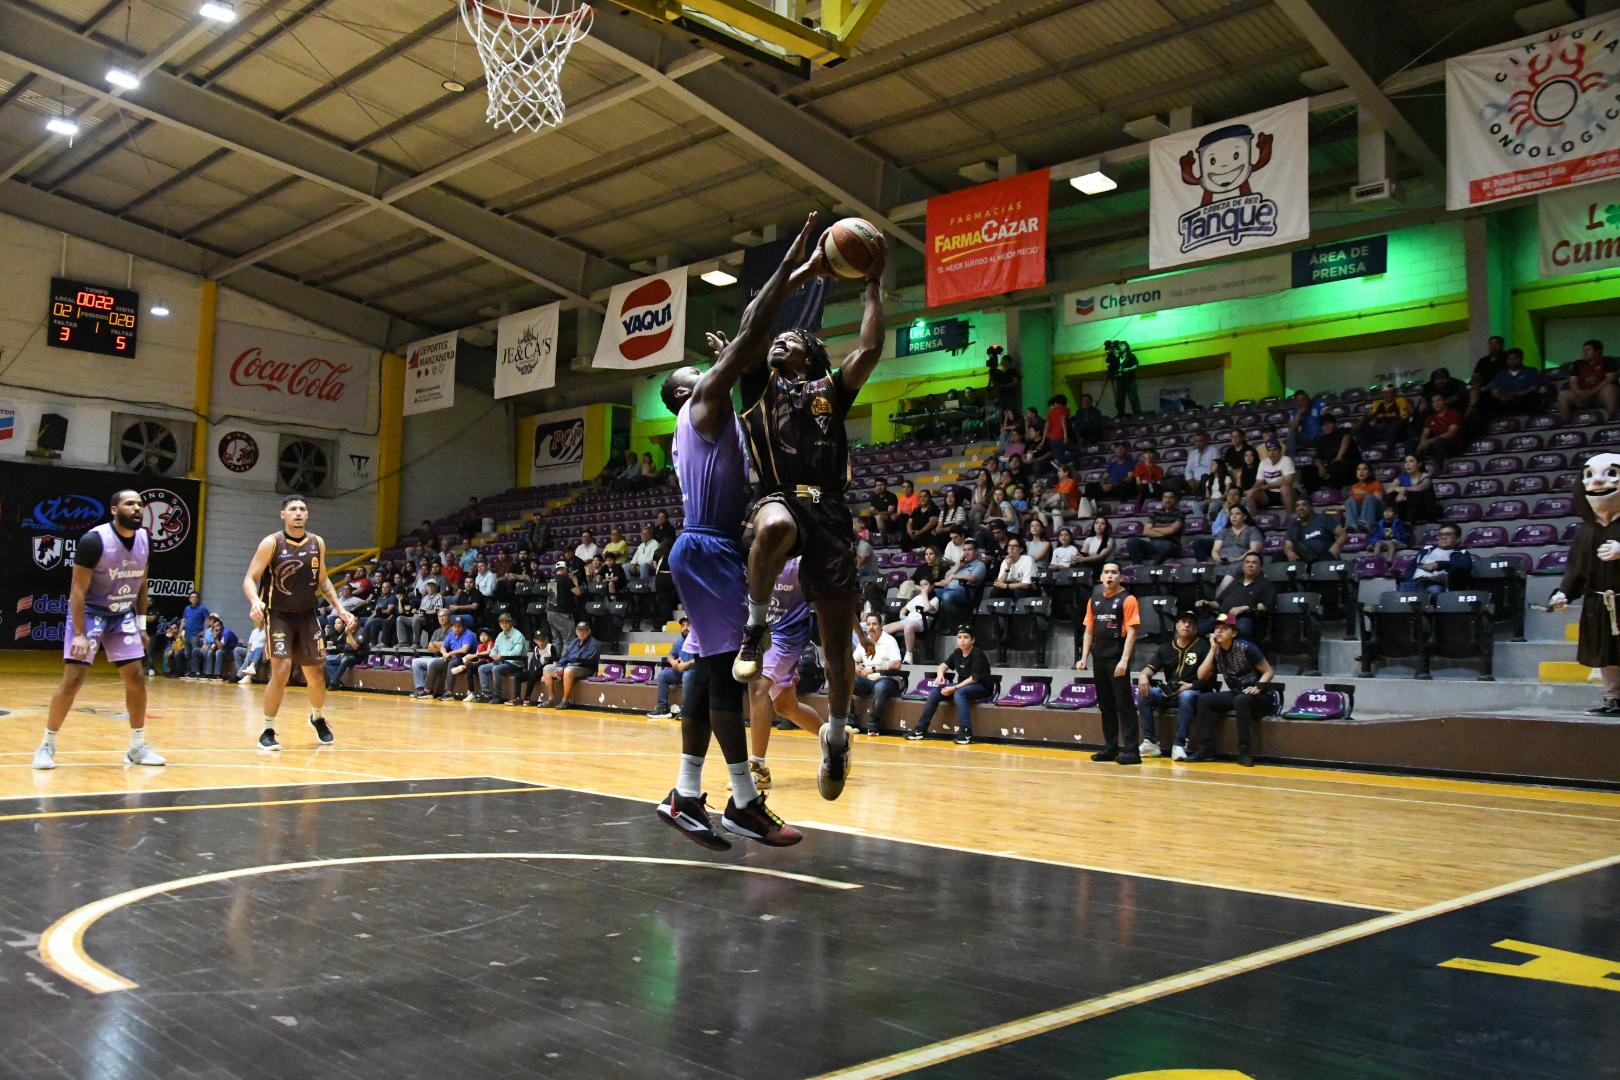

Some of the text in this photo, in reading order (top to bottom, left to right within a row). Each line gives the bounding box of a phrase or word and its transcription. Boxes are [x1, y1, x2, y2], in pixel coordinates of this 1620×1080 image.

[1495, 28, 1619, 83] CIRUGIA
[950, 201, 1022, 226] FARMACIAS
[1203, 196, 1259, 215] CABEZA DE RES
[1182, 203, 1274, 244] Tanque
[1351, 245, 1369, 258] DE
[1312, 261, 1367, 280] PRENSA
[77, 292, 114, 310] 0022
[1100, 288, 1161, 310] Chevron
[95, 321, 99, 334] 1
[109, 312, 135, 328] 028
[622, 303, 672, 336] YAQUI
[59, 326, 127, 350] 3 5
[933, 325, 946, 335] DE
[420, 341, 449, 355] DEPORTES
[909, 339, 944, 352] PRENSA
[420, 350, 455, 367] MANZANERO
[1309, 694, 1327, 702] R36
